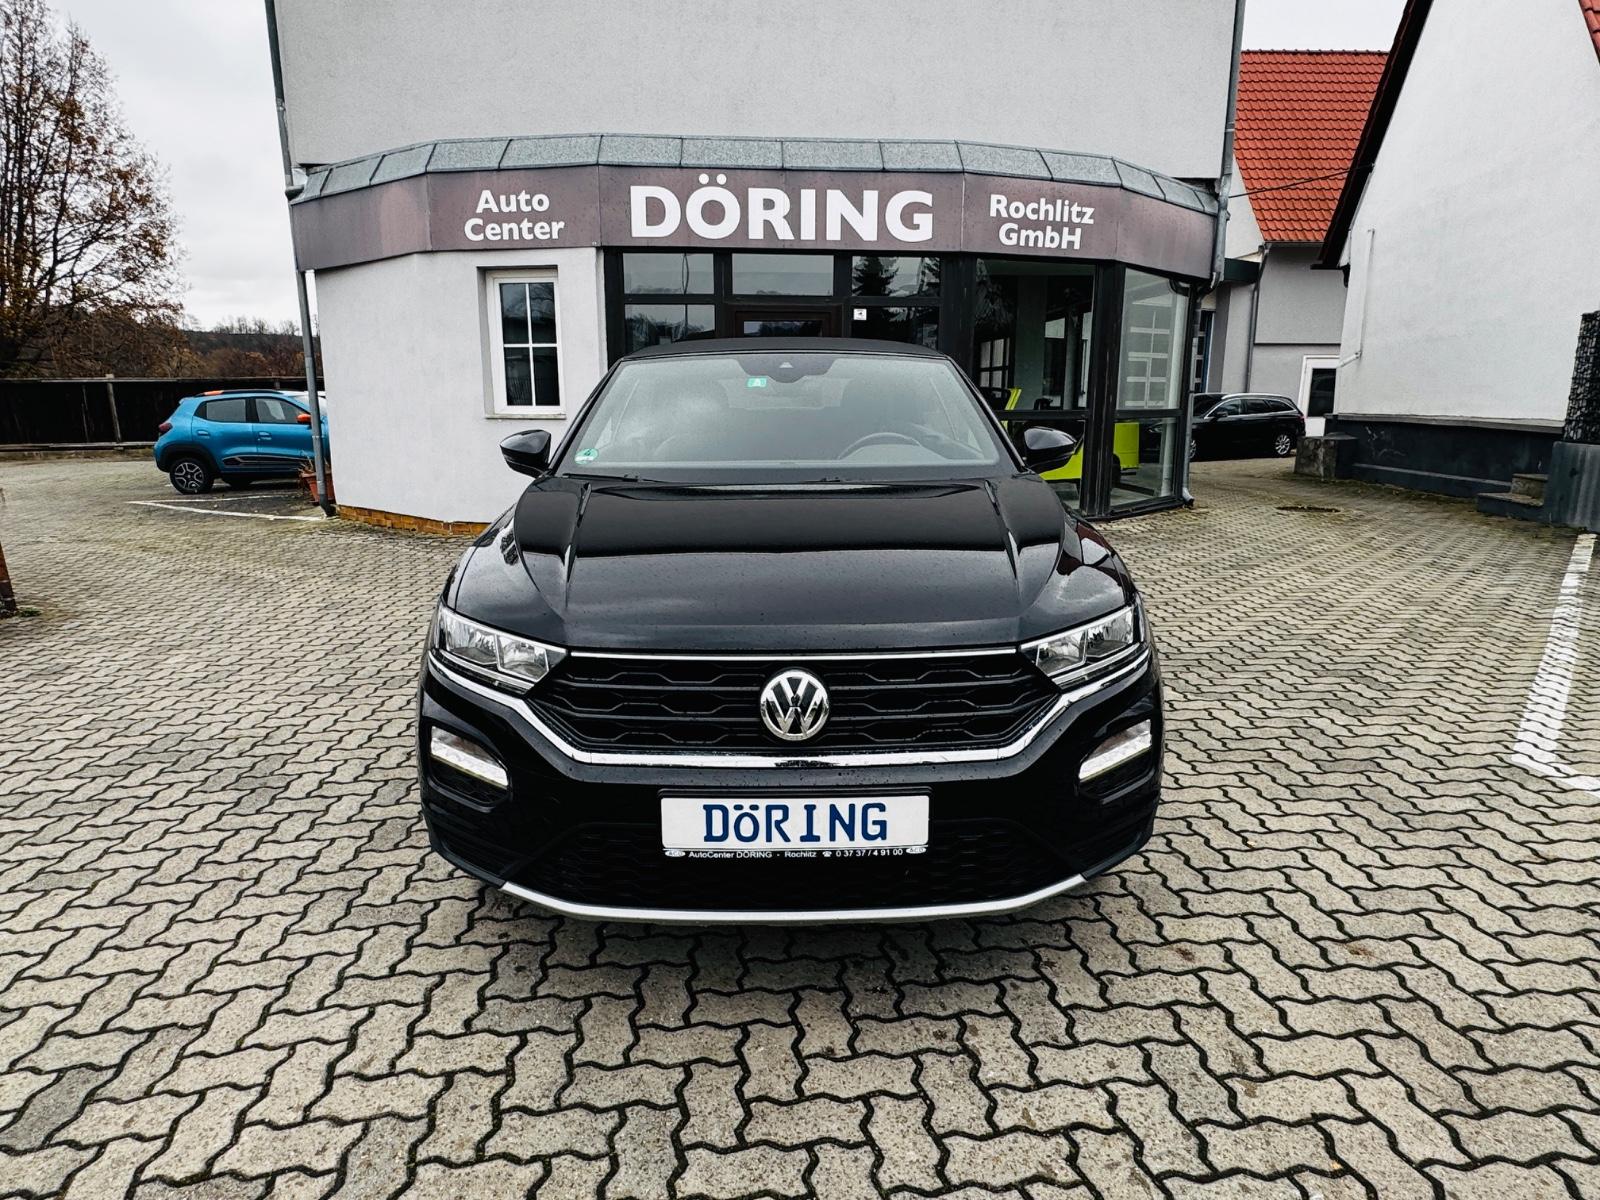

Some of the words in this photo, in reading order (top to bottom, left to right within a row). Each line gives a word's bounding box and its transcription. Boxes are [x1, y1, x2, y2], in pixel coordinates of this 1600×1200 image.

[475, 189, 550, 214] Auto
[630, 173, 933, 243] DÖRING
[989, 194, 1095, 225] Rochlitz
[464, 217, 565, 242] Center
[998, 223, 1082, 250] GmbH
[688, 851, 734, 859] AutoCenter
[736, 850, 773, 859] DÖRING
[784, 850, 817, 858] Rochlitz
[880, 848, 890, 856] 91
[892, 848, 903, 856] 00
